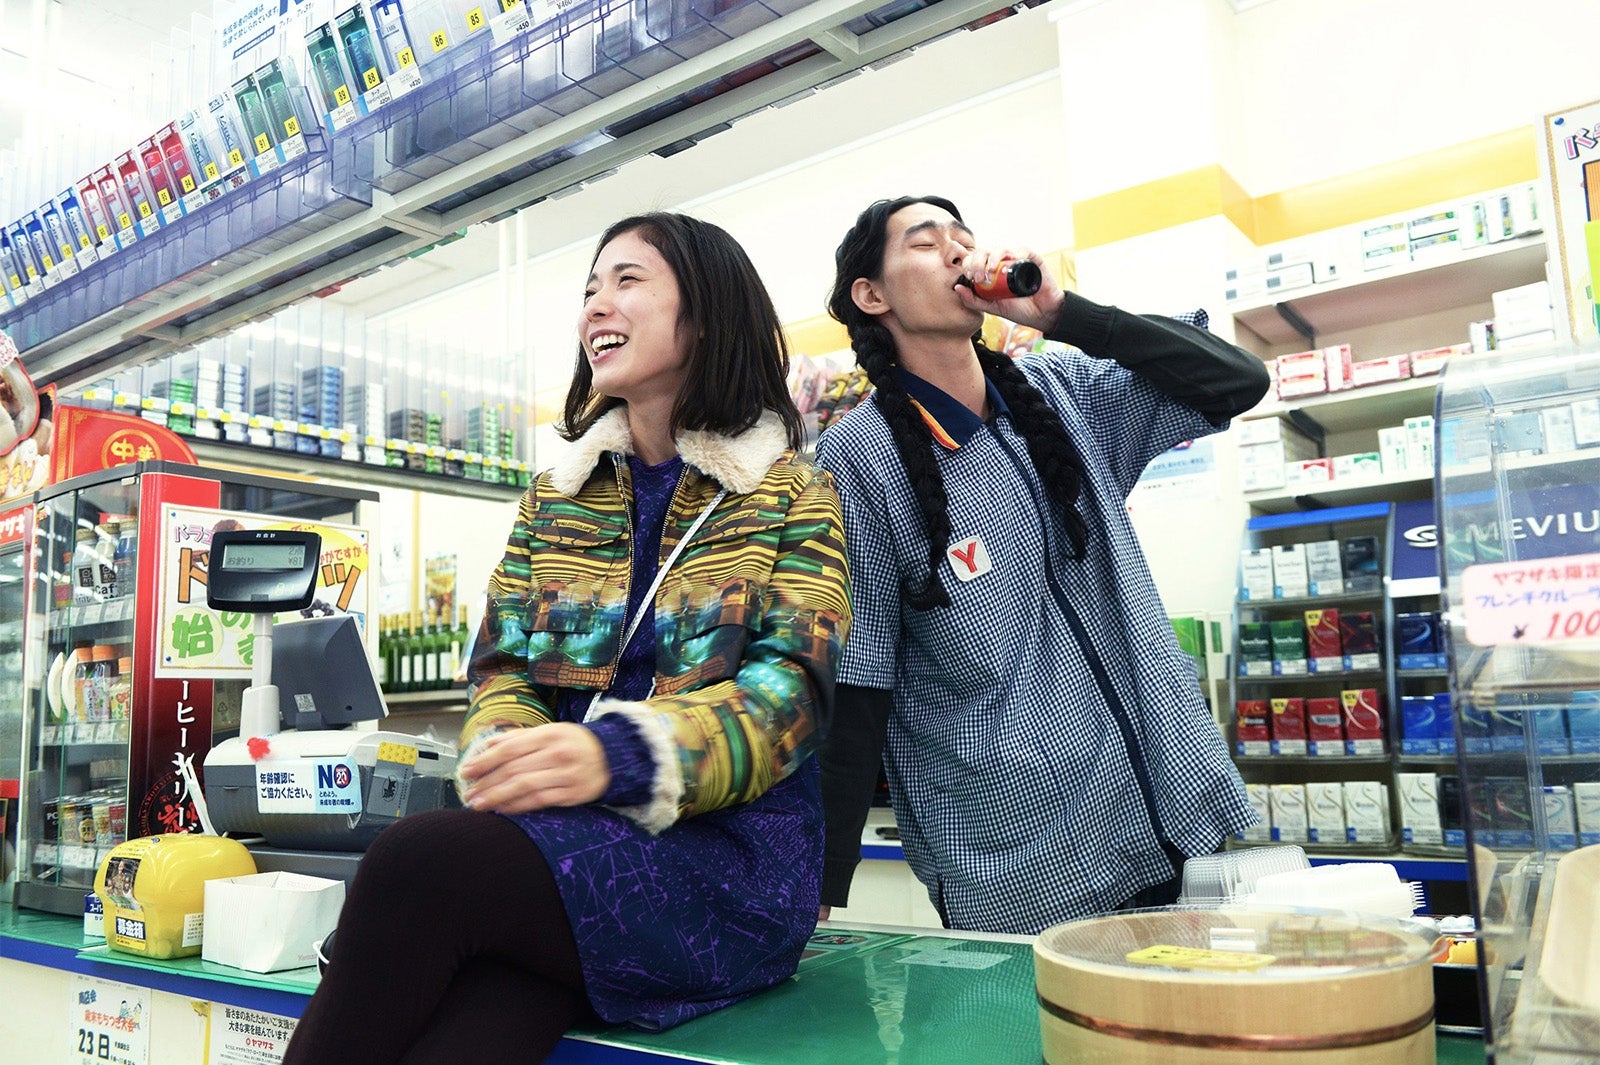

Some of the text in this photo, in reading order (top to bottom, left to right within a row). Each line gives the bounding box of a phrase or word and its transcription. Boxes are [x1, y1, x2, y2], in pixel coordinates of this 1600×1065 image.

[471, 14, 480, 25] 85
[434, 34, 444, 45] 86
[401, 52, 411, 64] 87
[951, 541, 978, 573] Y
[260, 772, 295, 785] 年齢確認に
[261, 787, 313, 799] ご協力ください。
[117, 918, 144, 939] 募金箱
[251, 1039, 274, 1051] ヤマザキ
